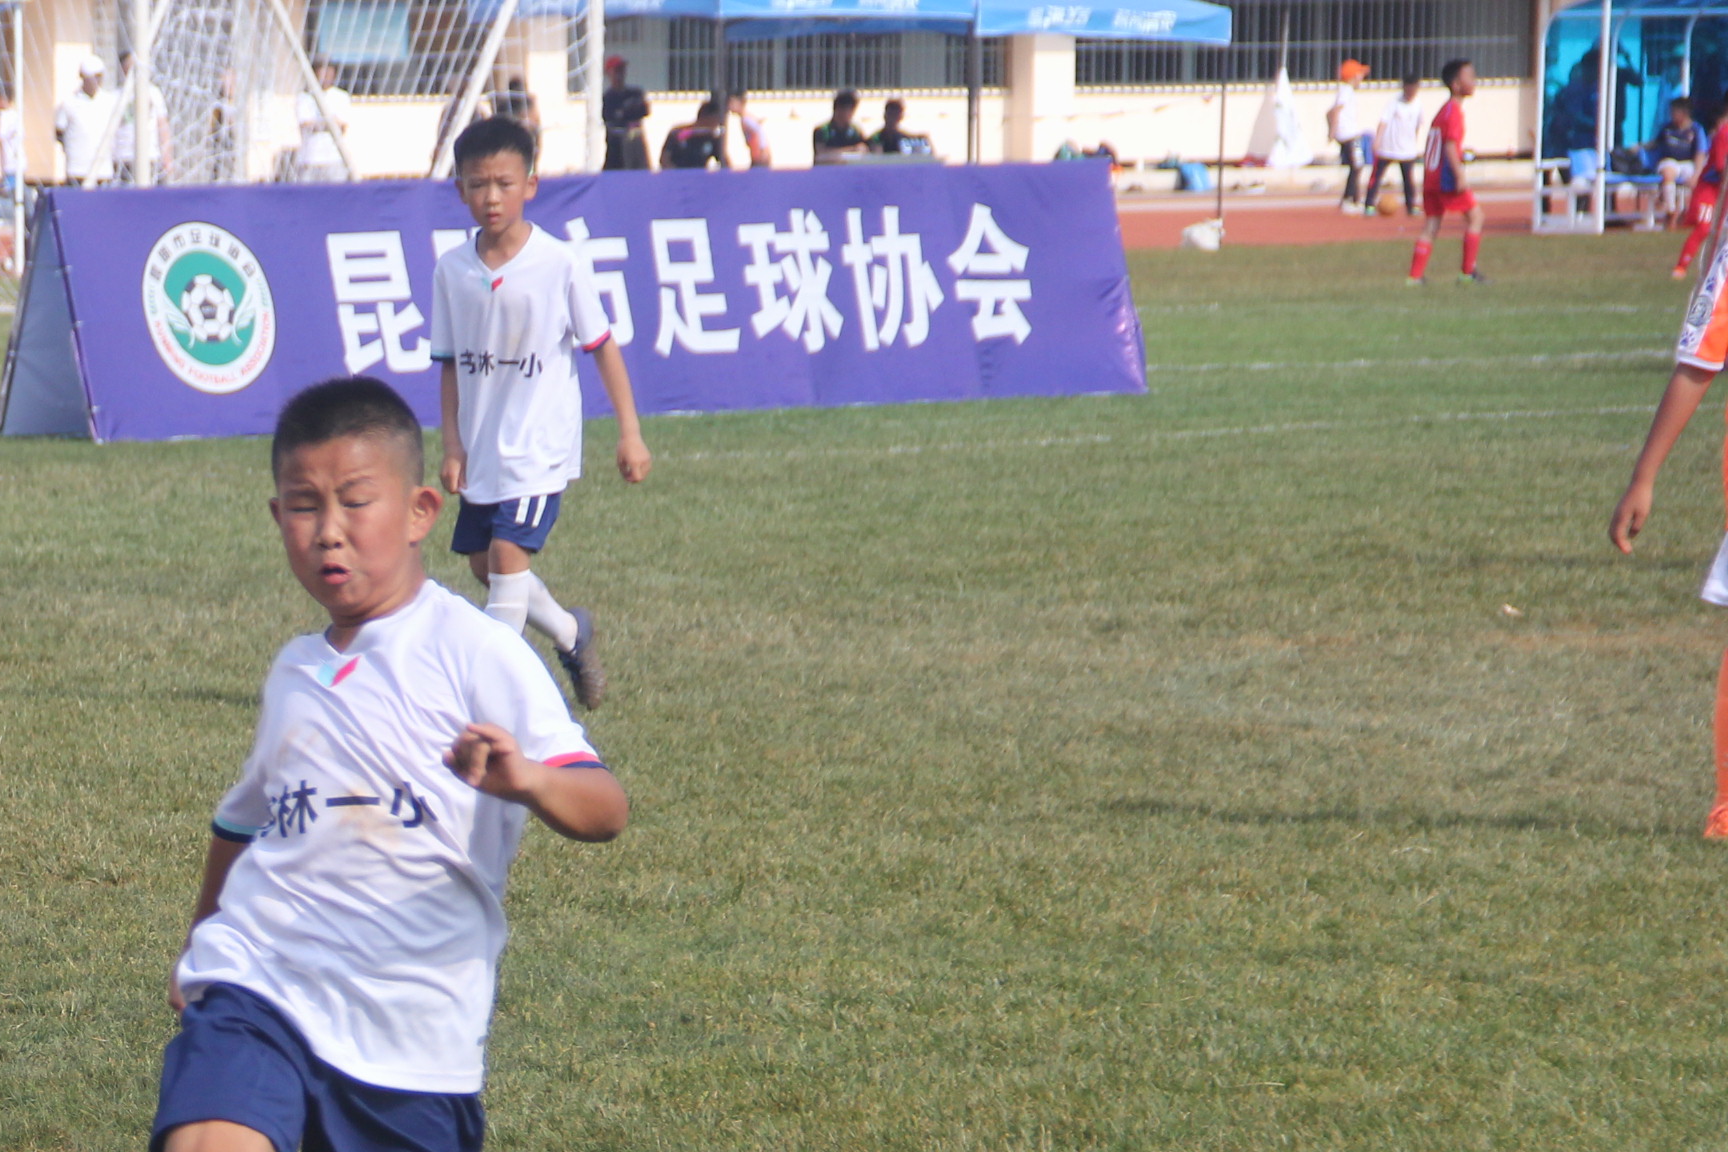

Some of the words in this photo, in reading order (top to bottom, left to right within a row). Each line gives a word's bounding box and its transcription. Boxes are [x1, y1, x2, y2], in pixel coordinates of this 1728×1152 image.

[326, 203, 1033, 376] 昆市足球协会
[515, 494, 548, 528] 11
[260, 779, 438, 838] 林一小
